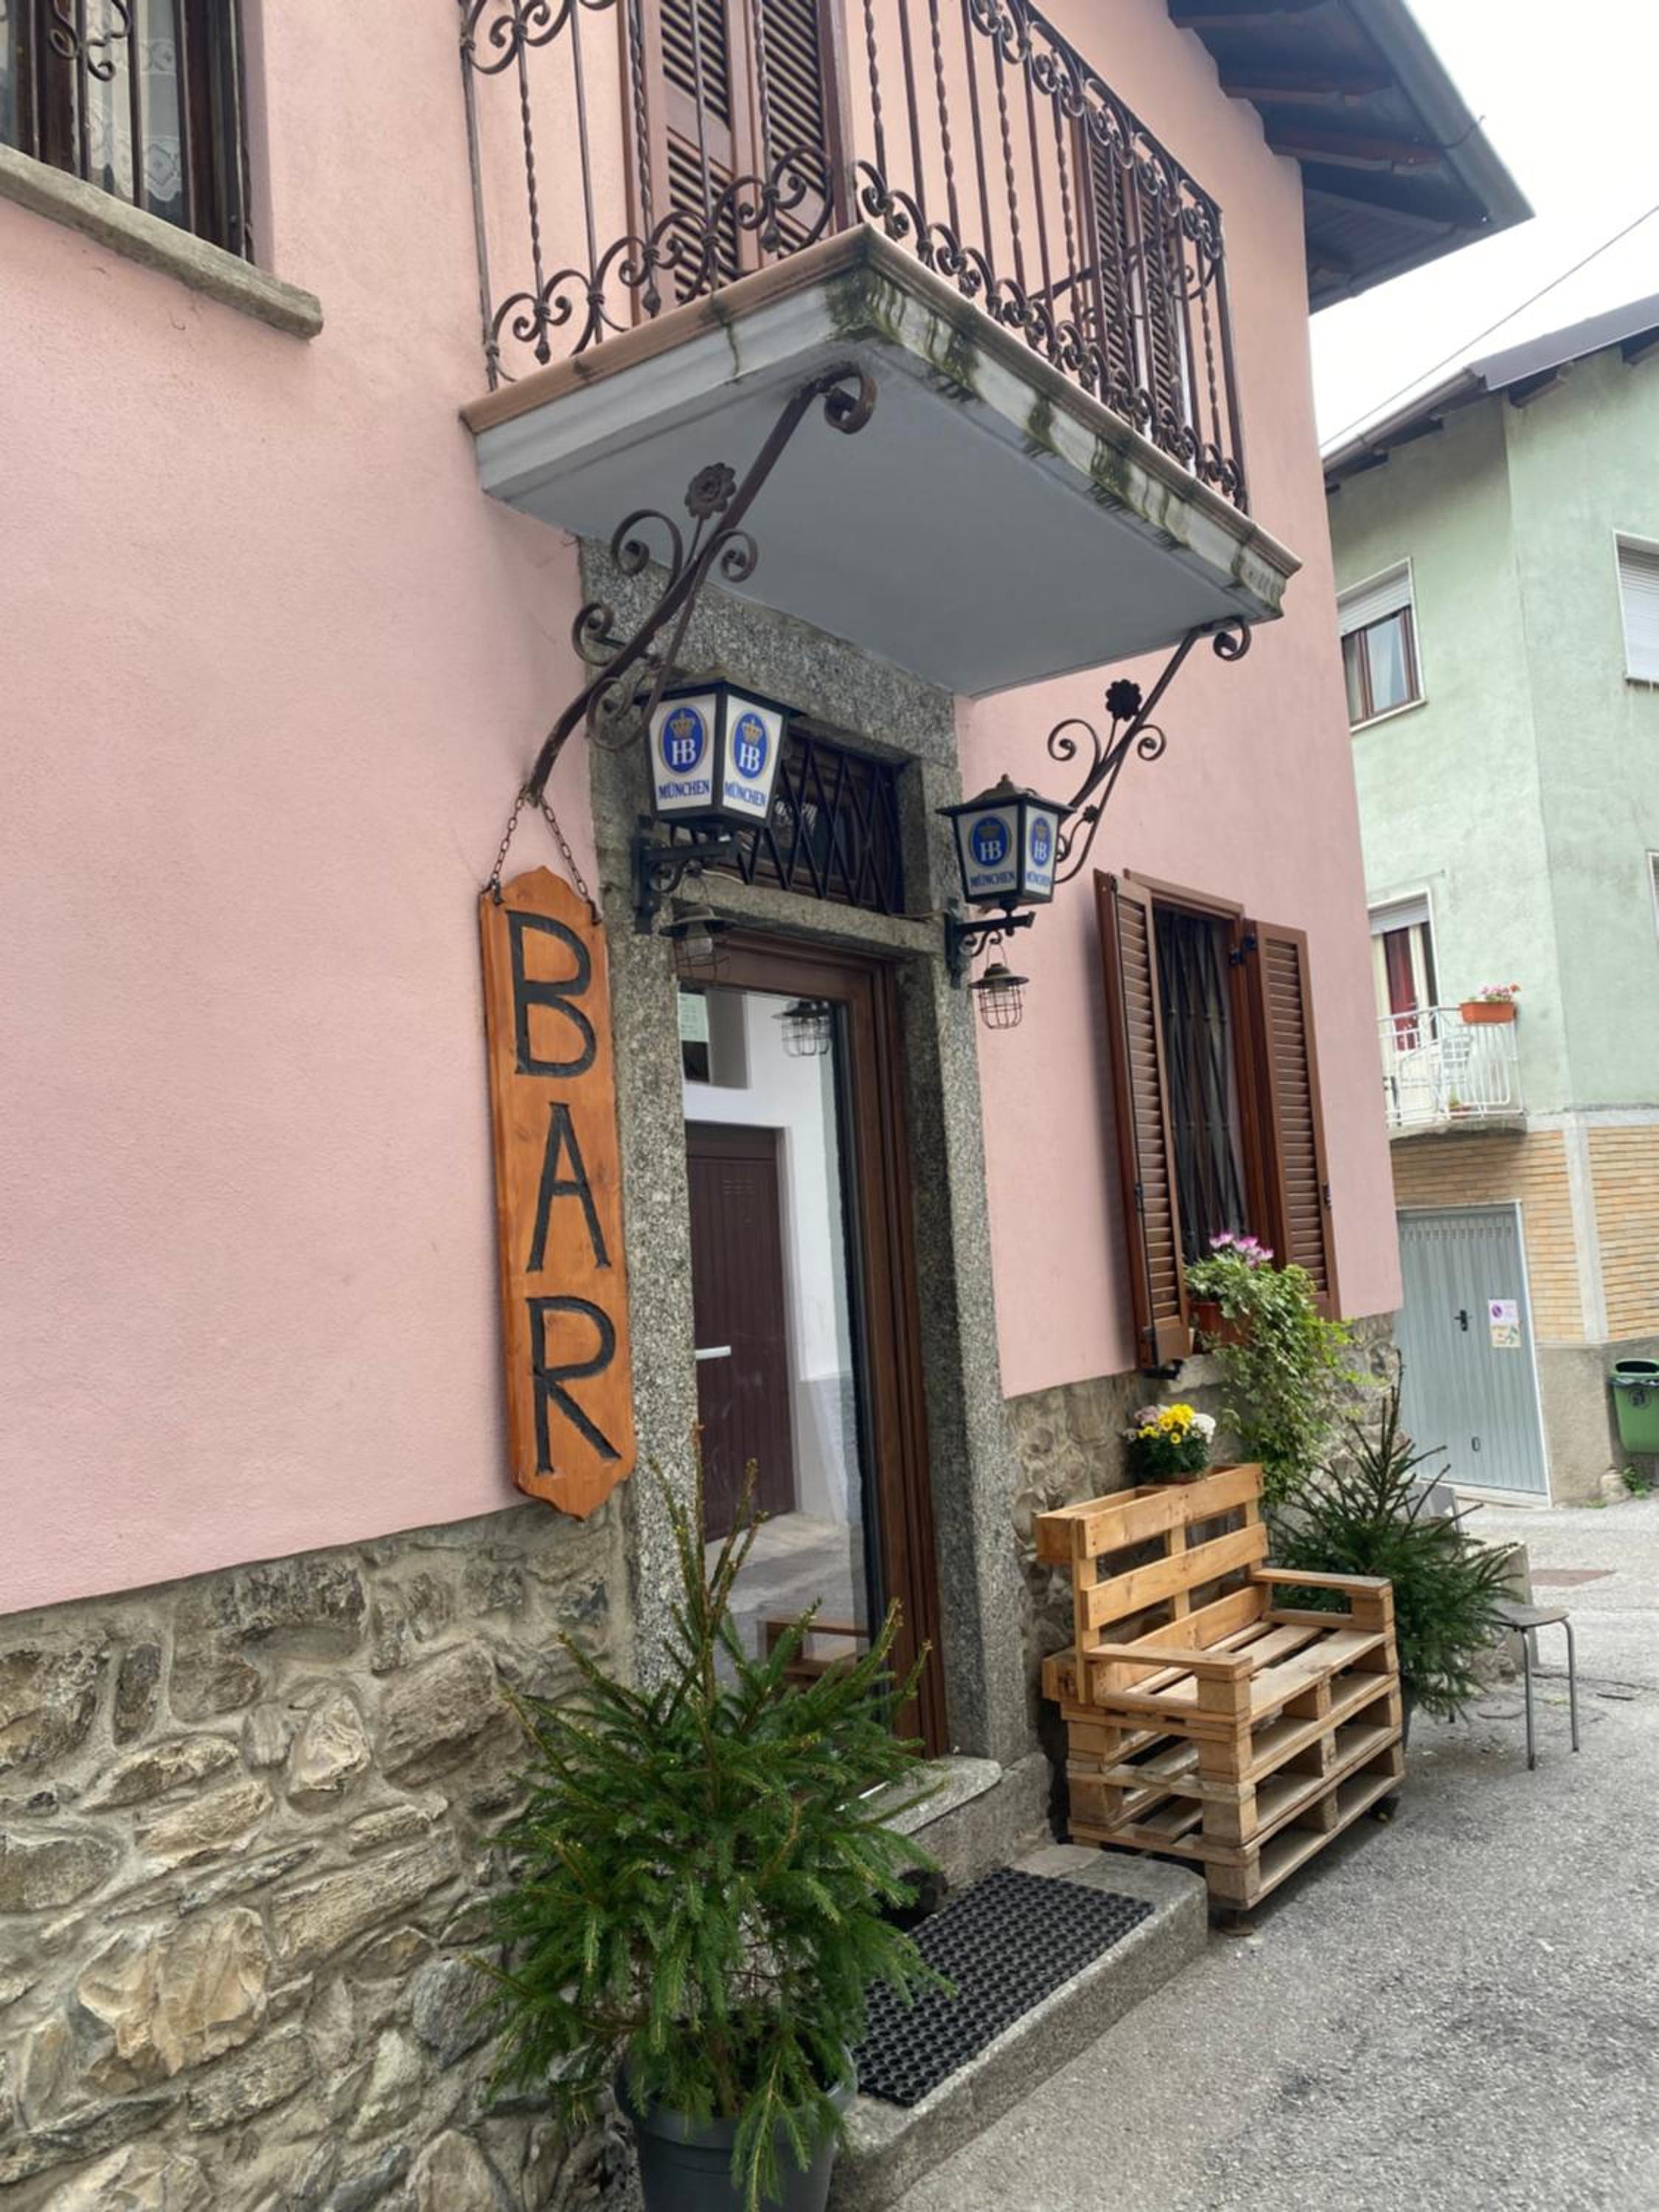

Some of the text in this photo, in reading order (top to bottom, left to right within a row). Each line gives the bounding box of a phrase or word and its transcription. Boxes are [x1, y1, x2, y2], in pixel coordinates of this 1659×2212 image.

[672, 737, 697, 766] HB
[739, 742, 762, 772] HB
[658, 778, 711, 800] MÜNCHEN
[724, 780, 768, 807] MÜNCHEN
[979, 839, 1003, 862] HB
[506, 908, 623, 1475] BAR
